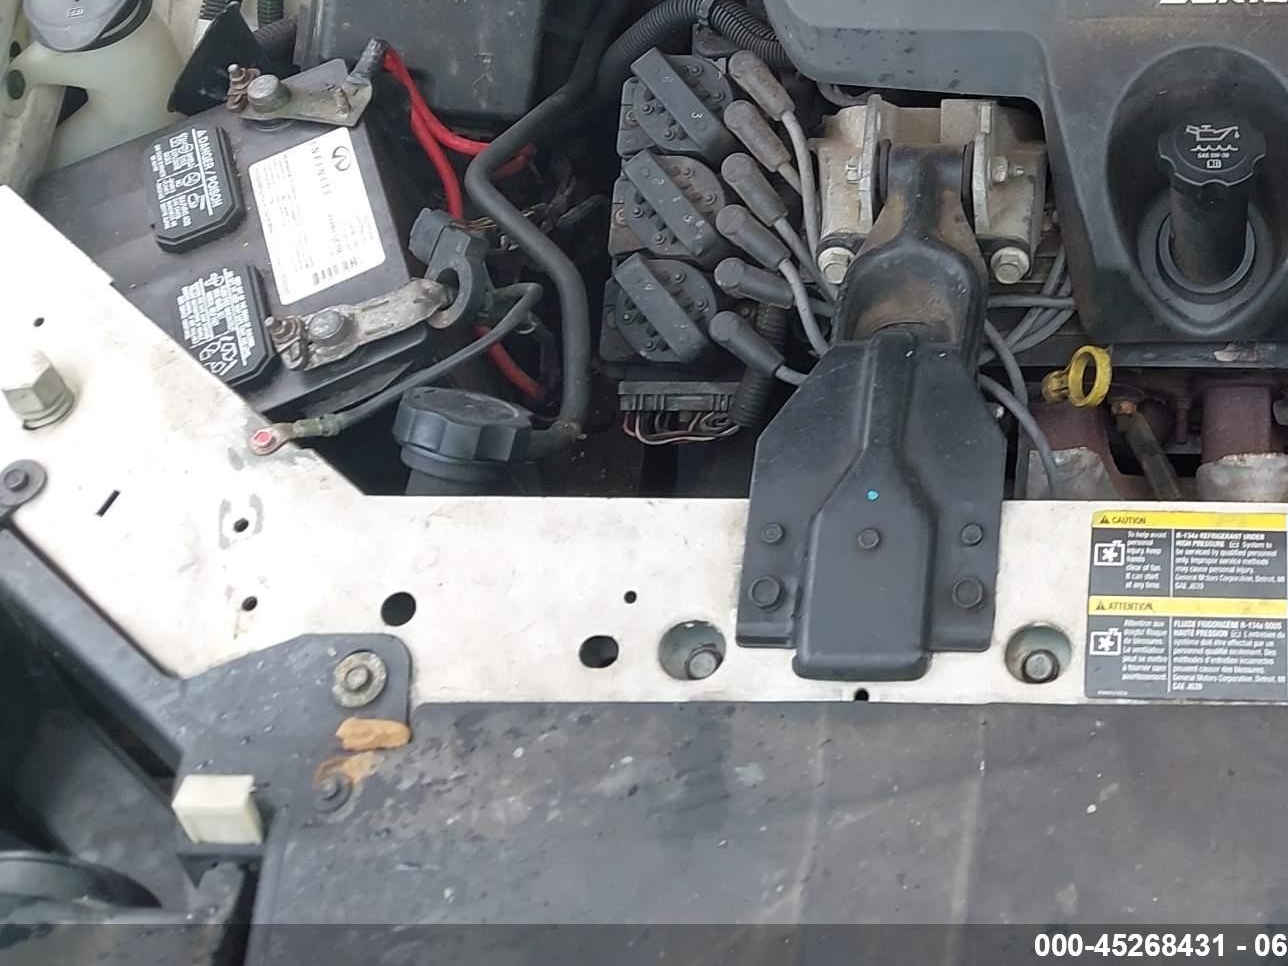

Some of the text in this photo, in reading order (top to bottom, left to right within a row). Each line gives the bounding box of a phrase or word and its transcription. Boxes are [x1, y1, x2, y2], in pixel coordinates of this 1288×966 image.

[691, 111, 703, 119] 3
[197, 136, 215, 170] DANGER
[206, 175, 223, 208] POISON
[309, 140, 331, 196] INFINITI
[1108, 602, 1153, 610] ATTENTION
